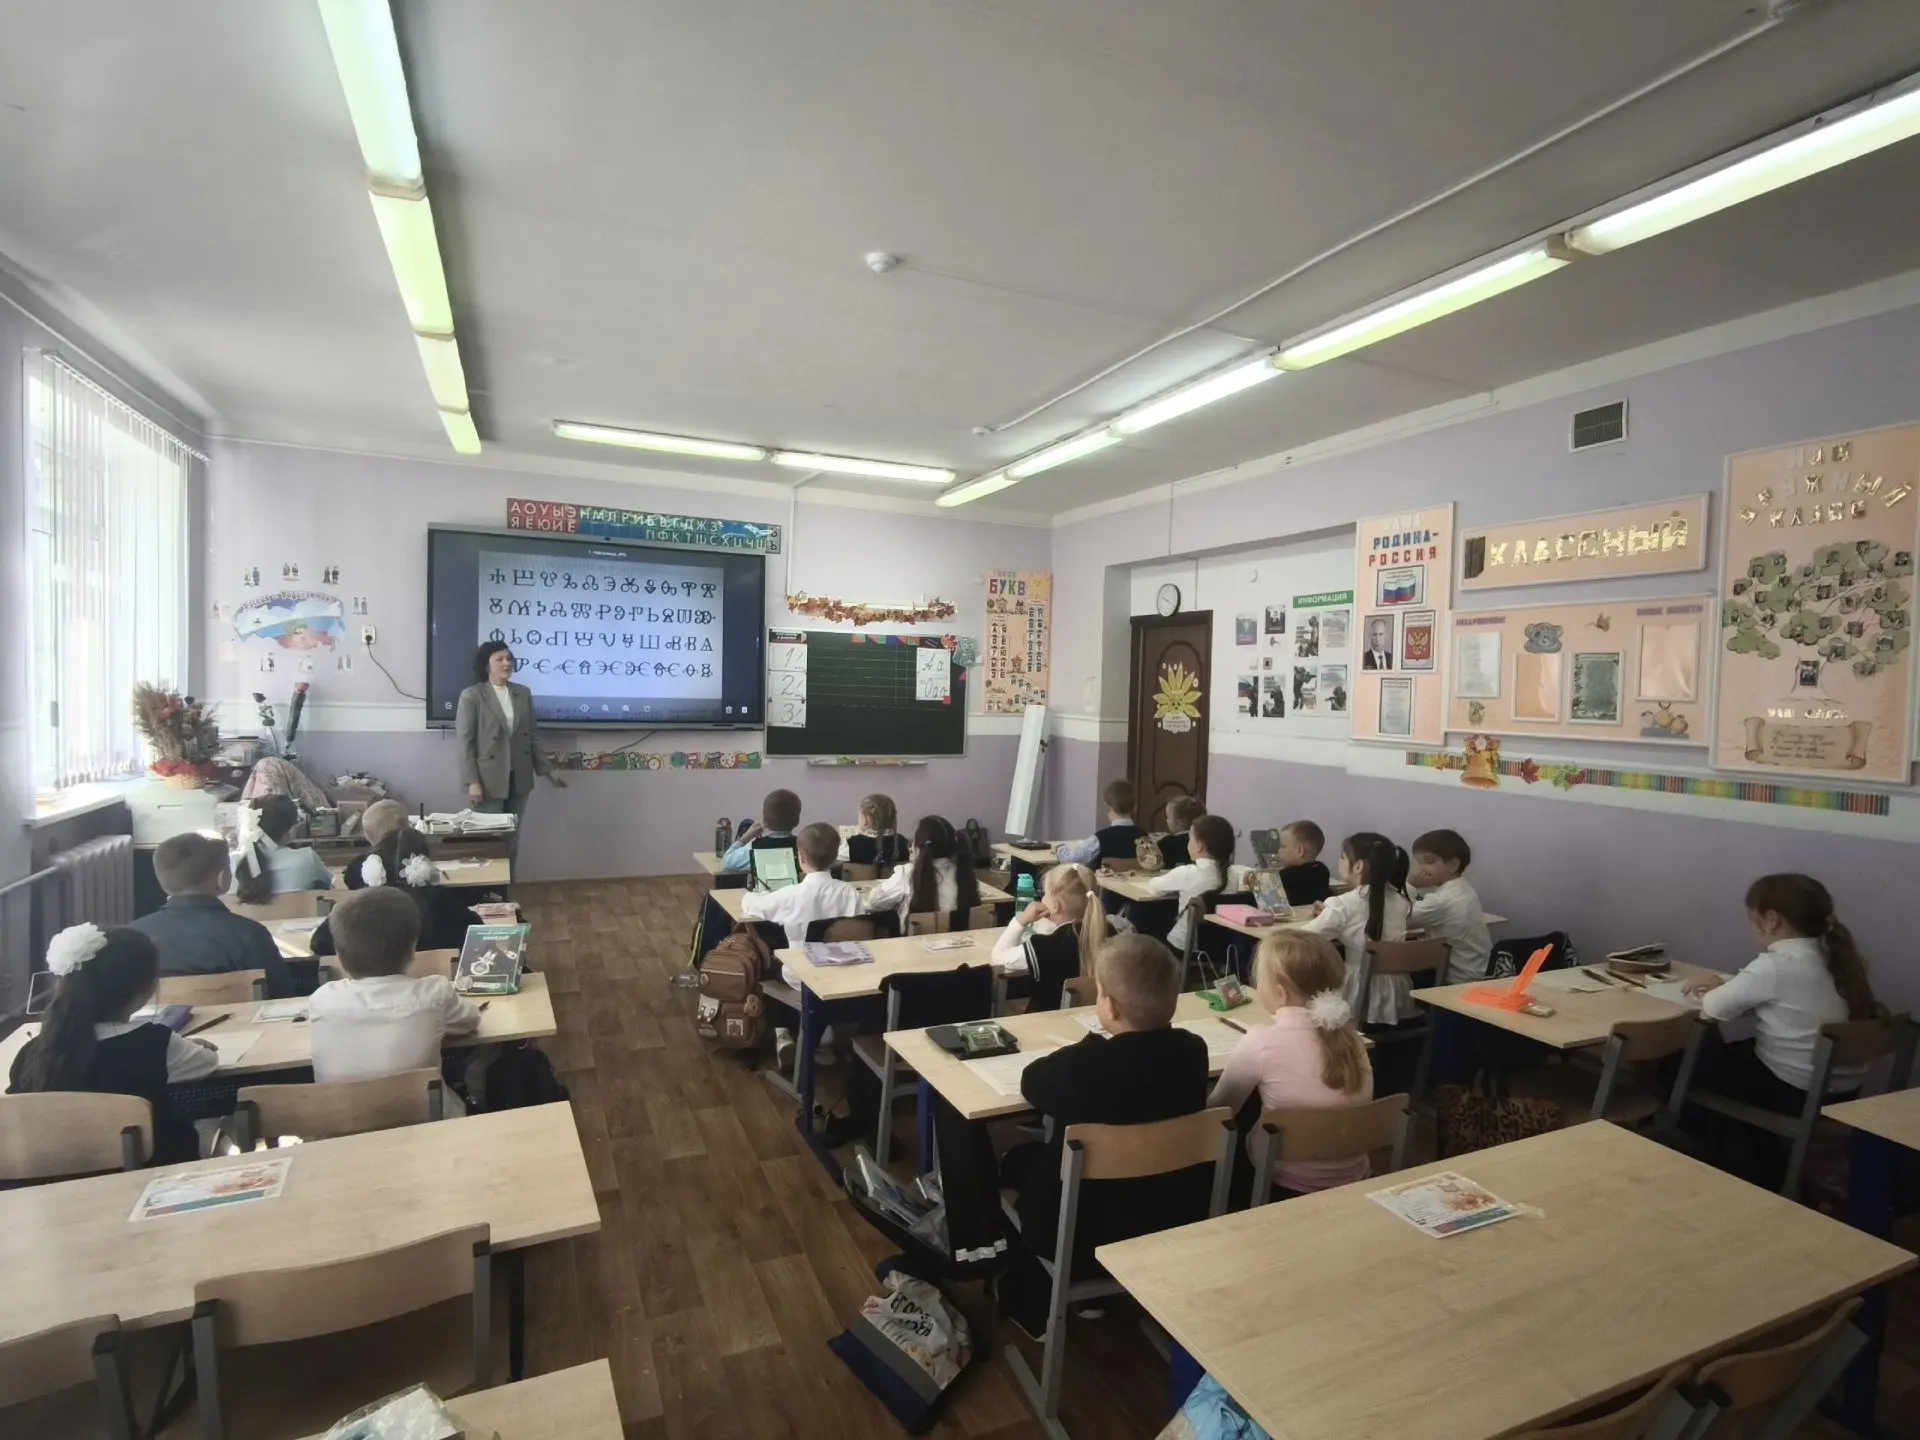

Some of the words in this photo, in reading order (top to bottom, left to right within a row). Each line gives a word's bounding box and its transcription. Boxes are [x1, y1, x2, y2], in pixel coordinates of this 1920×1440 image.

[1490, 510, 1688, 567] КЛАССНЫЙ
[1368, 546, 1436, 567] РОССИЯ
[989, 579, 1026, 595] БУКВ
[1297, 592, 1348, 605] ИНФОРМАЦИЯ
